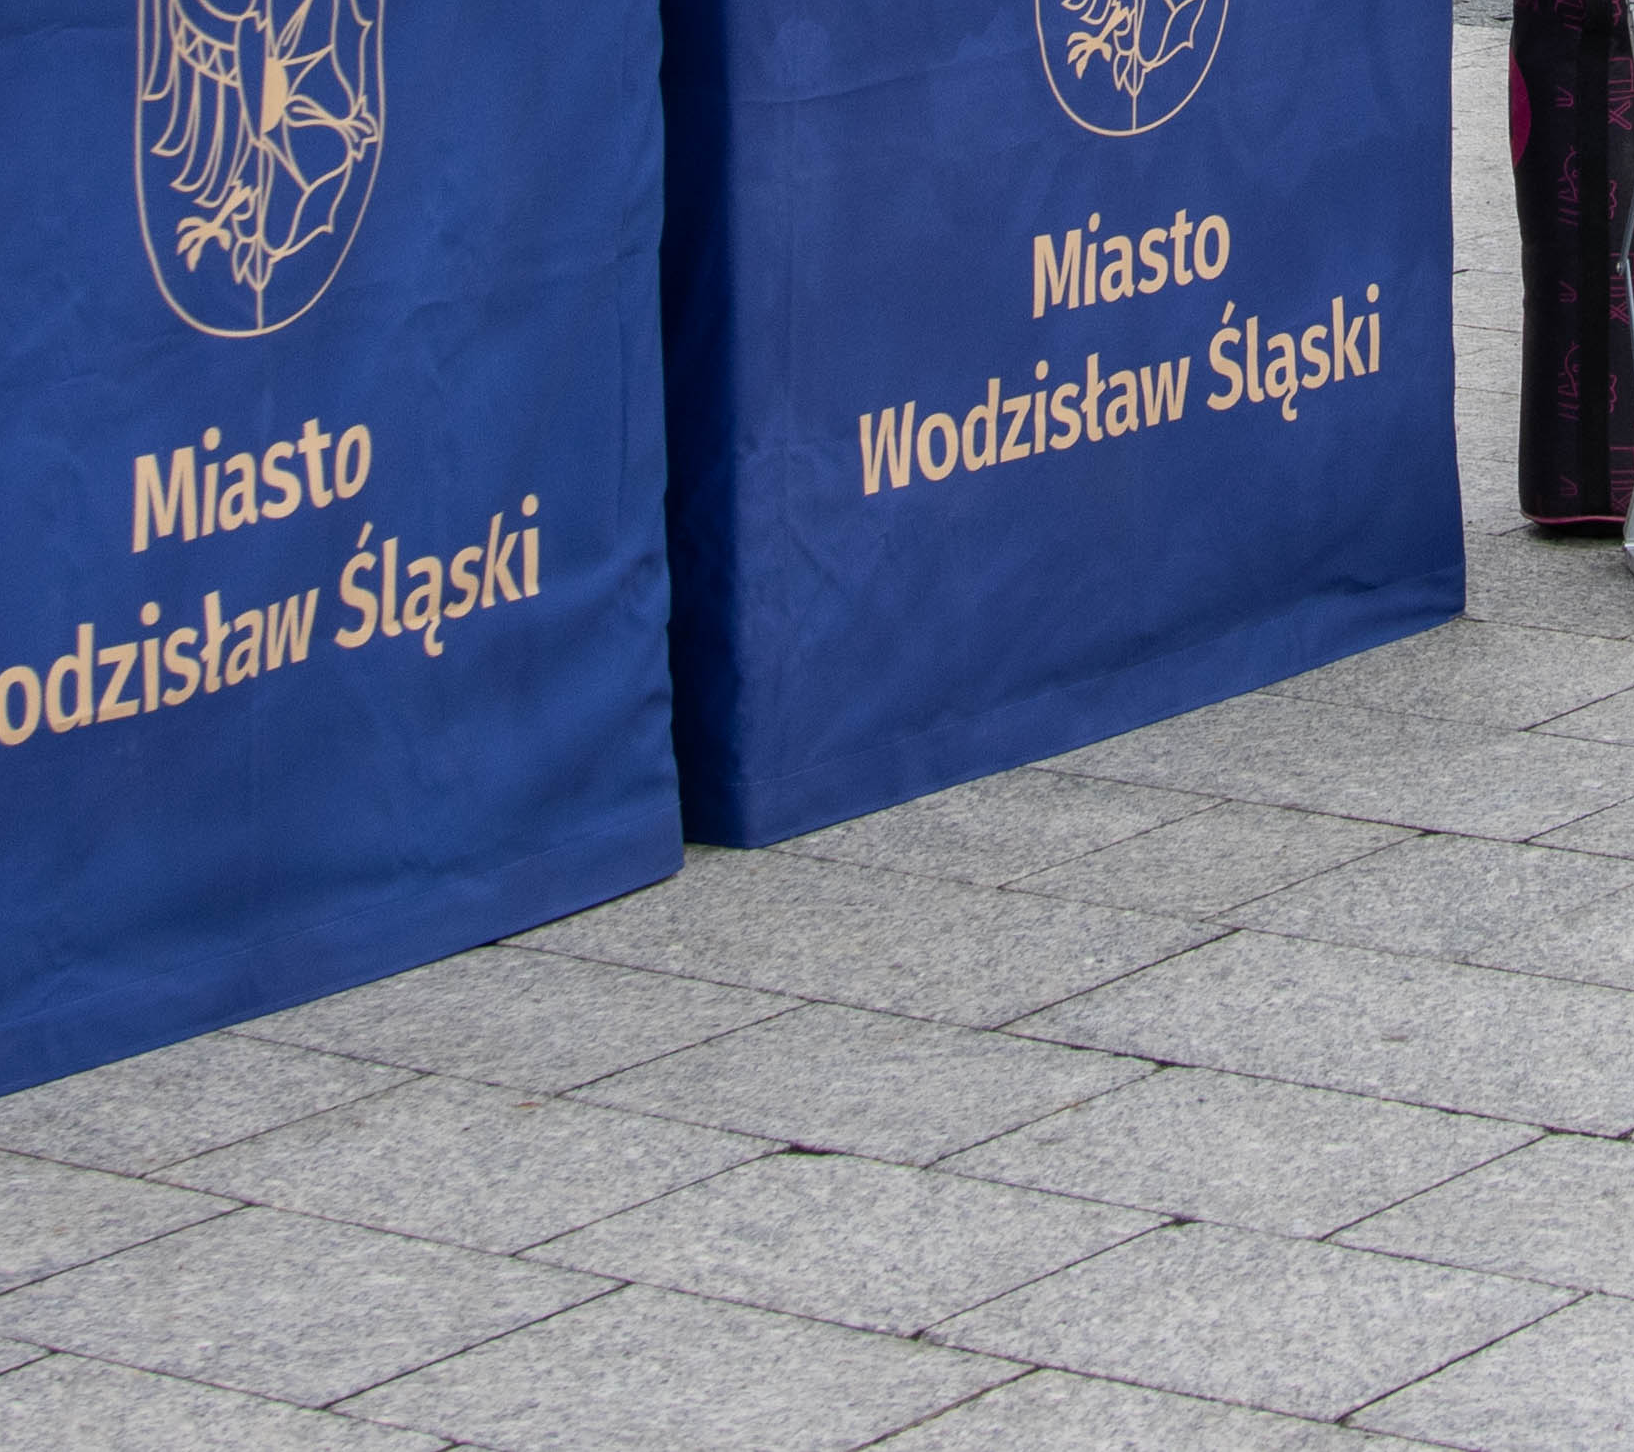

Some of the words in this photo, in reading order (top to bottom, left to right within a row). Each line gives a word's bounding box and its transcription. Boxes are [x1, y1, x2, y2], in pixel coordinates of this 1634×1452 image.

[1033, 208, 1231, 319] Miasto
[859, 352, 1191, 496] Wodzisław
[1207, 283, 1381, 421] Śląski
[132, 418, 372, 553] Miasto
[334, 494, 541, 657] Śląski
